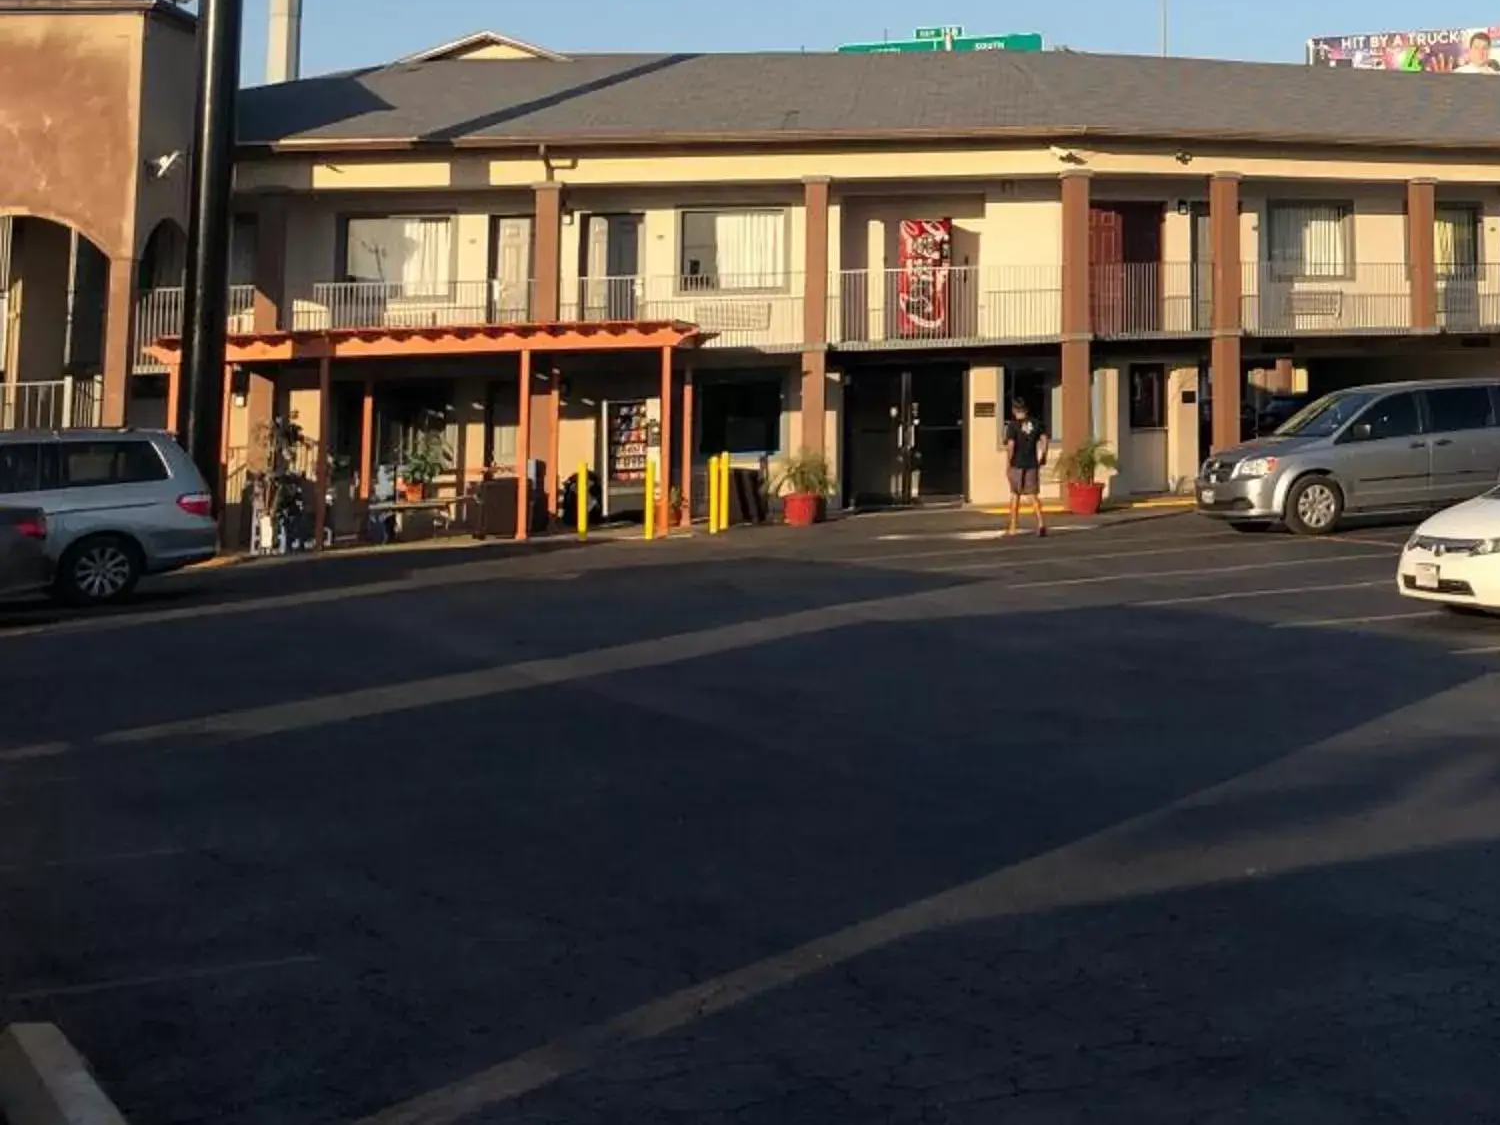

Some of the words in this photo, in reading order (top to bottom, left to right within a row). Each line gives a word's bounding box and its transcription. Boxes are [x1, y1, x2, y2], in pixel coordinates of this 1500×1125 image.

[1340, 36, 1366, 49] HIT
[1370, 34, 1389, 48] BY
[1394, 34, 1403, 46] A
